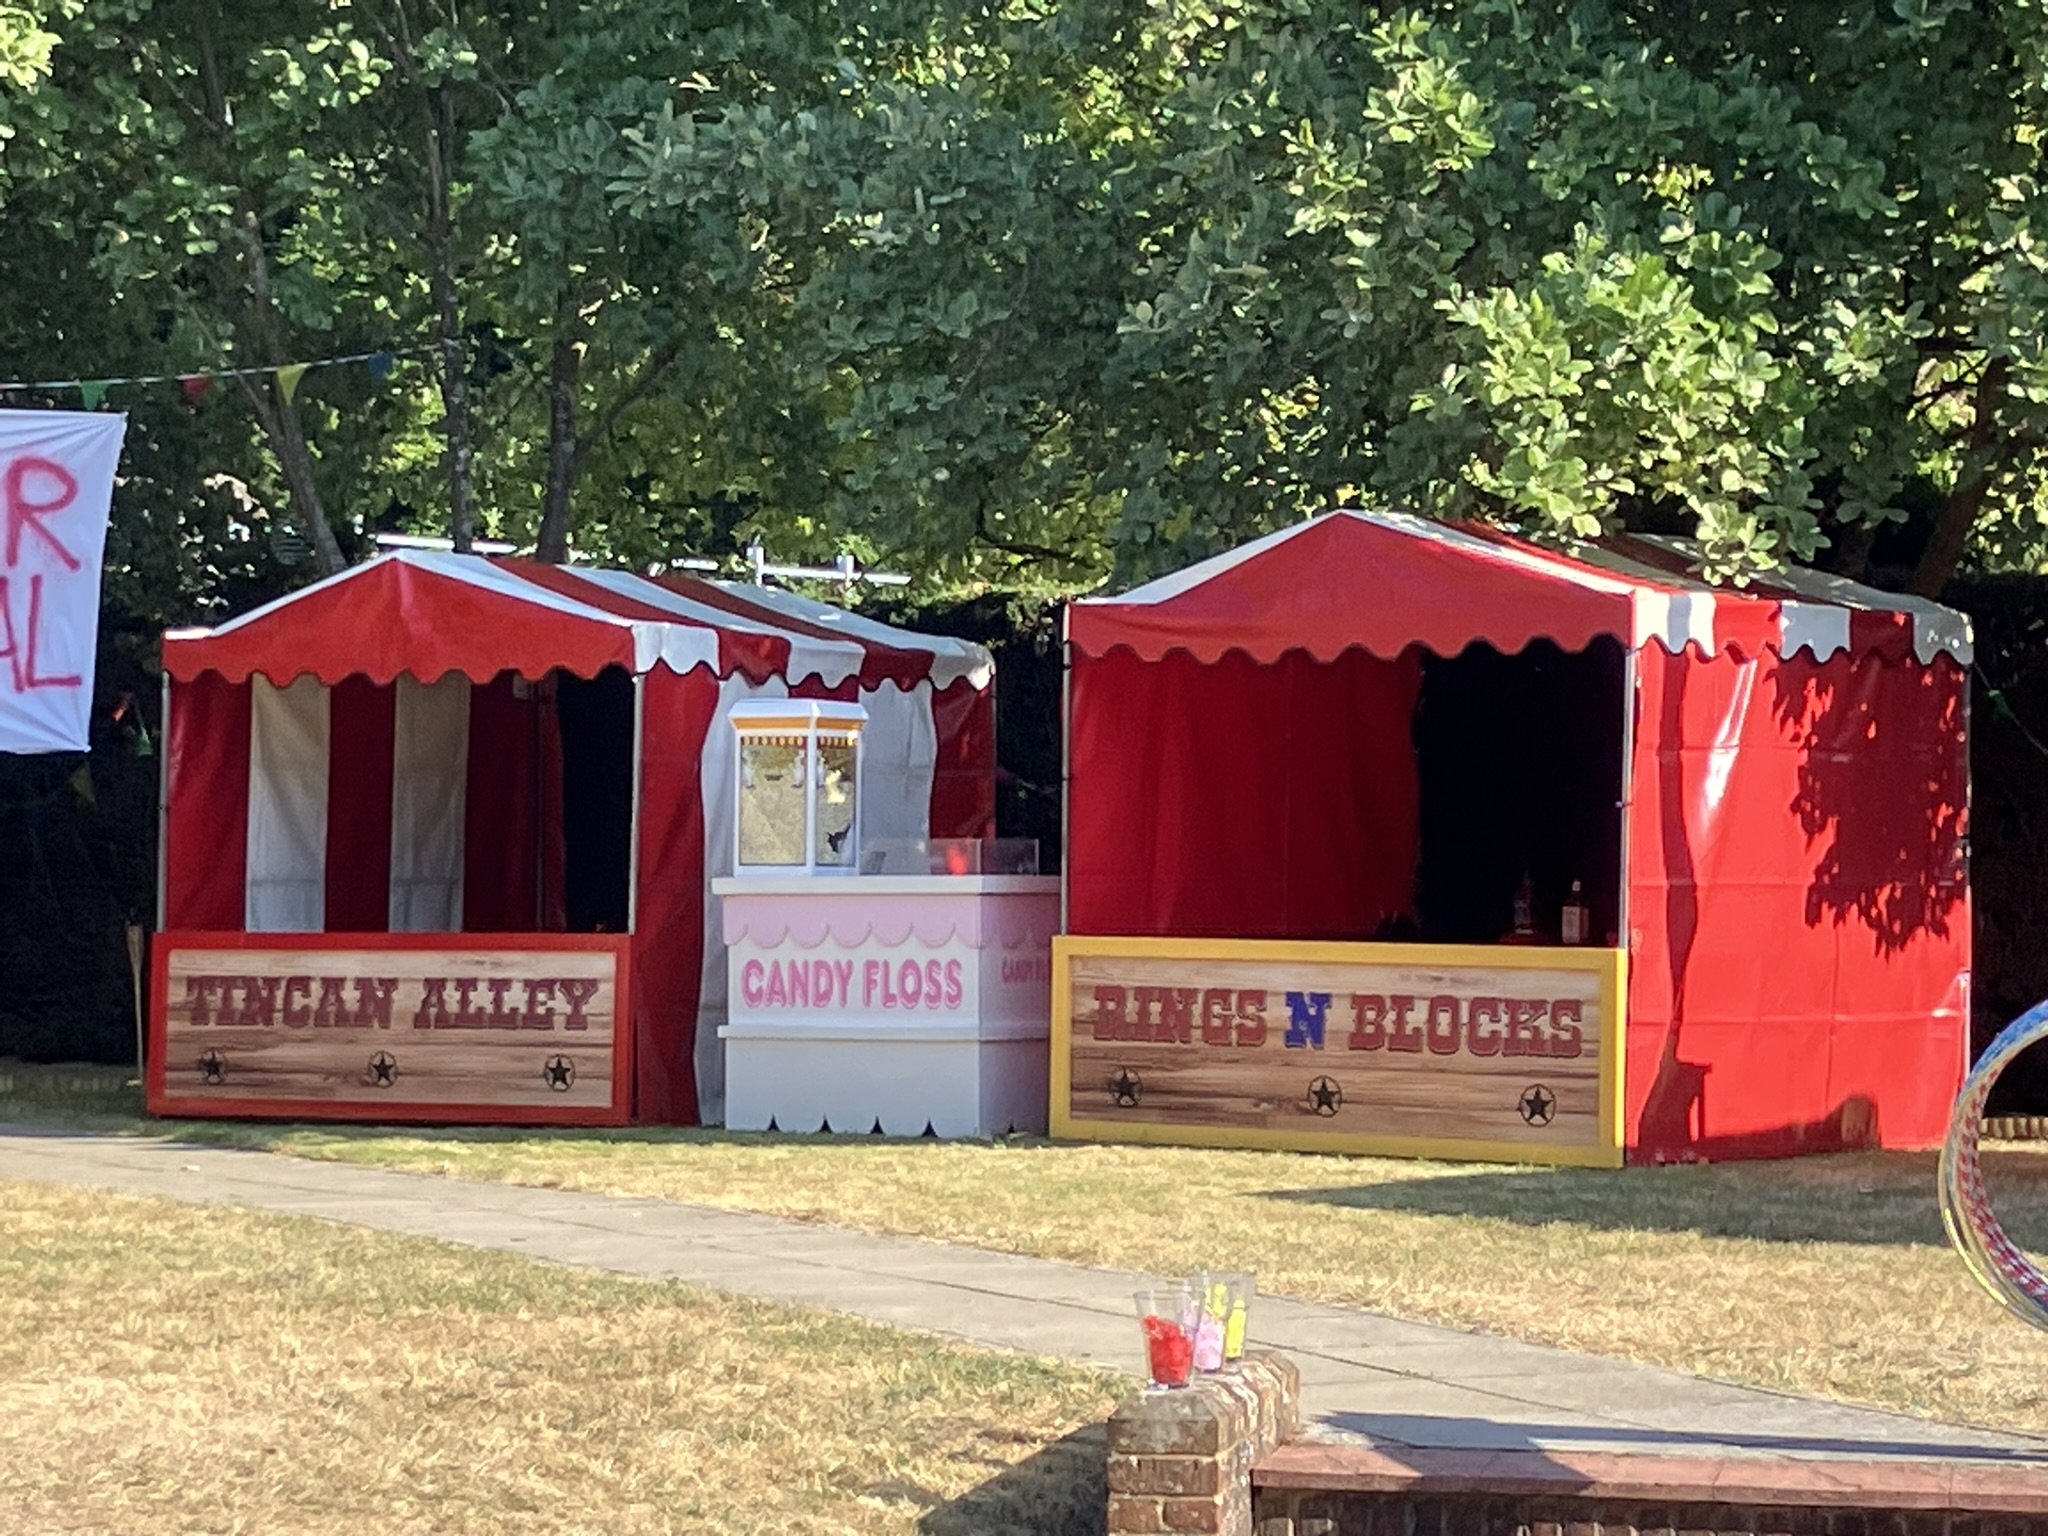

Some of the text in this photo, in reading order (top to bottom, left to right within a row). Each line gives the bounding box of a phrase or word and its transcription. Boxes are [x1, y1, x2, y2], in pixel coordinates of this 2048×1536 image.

[186, 975, 599, 1030] TINCAN ALLEY
[741, 959, 963, 1010] CANDY FLOSS
[1093, 985, 1583, 1058] RINGS N BLOCKS
